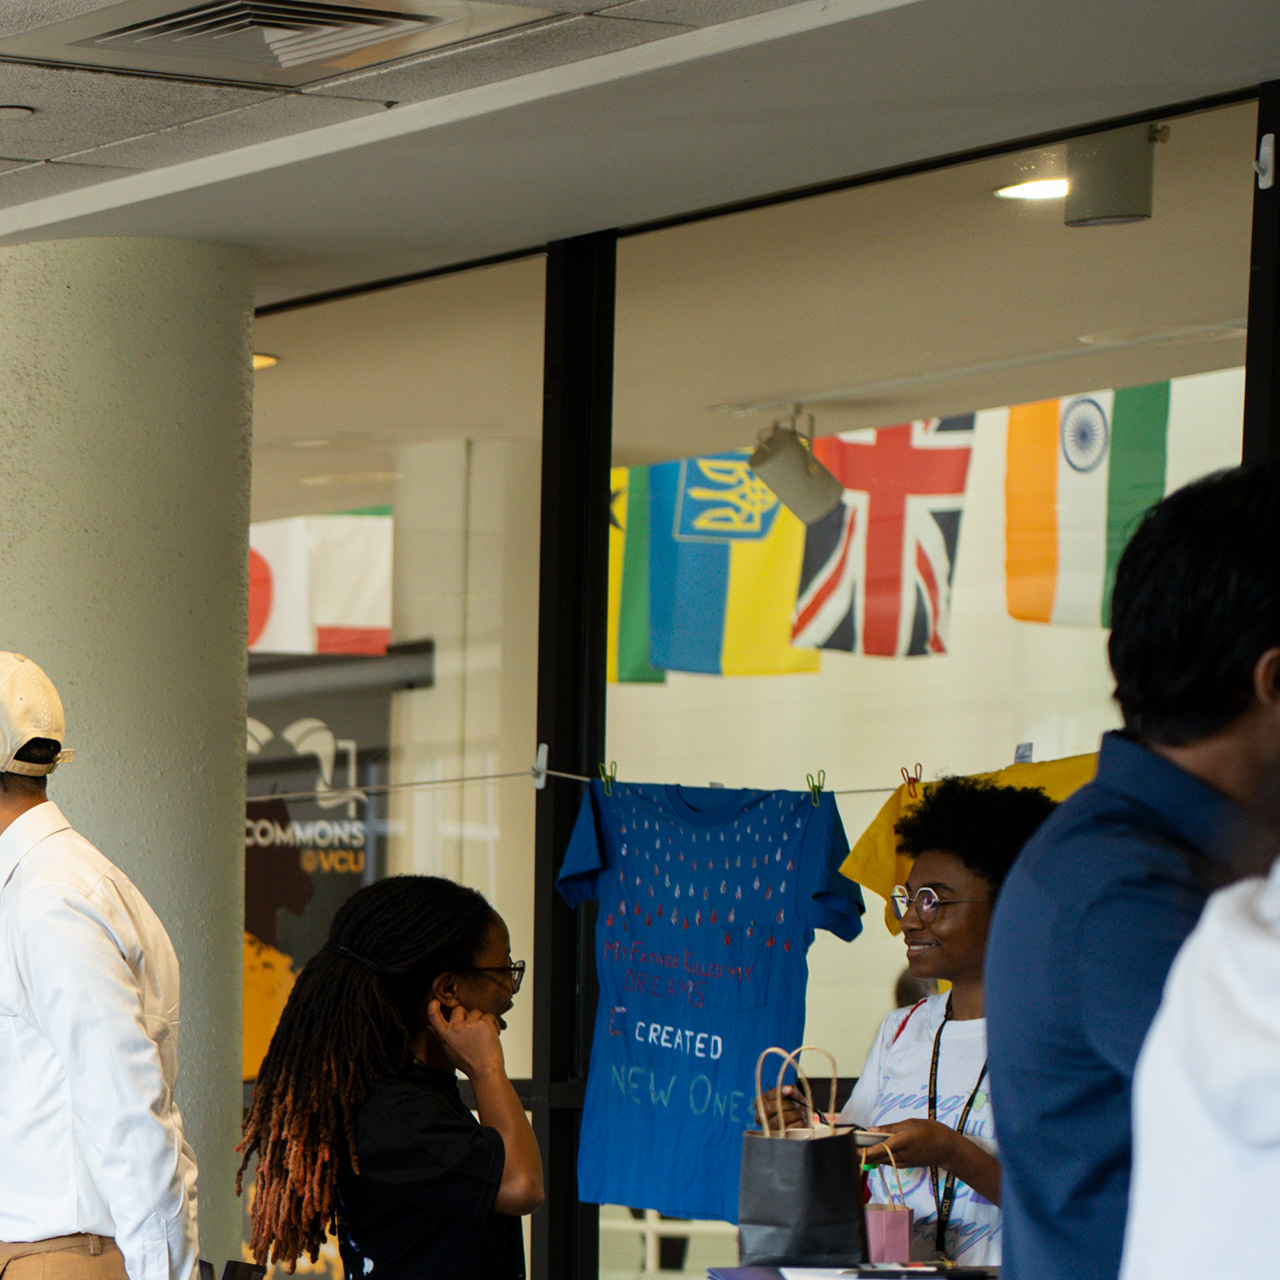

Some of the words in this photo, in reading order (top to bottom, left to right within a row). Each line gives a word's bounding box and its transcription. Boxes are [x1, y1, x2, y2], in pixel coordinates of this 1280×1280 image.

[684, 948, 724, 980] KILLED
[727, 965, 753, 983] MY
[624, 968, 708, 1009] DREAMS
[635, 1021, 723, 1060] CREATED
[611, 1063, 677, 1107] NEW
[942, 1199, 951, 1216] VCU
